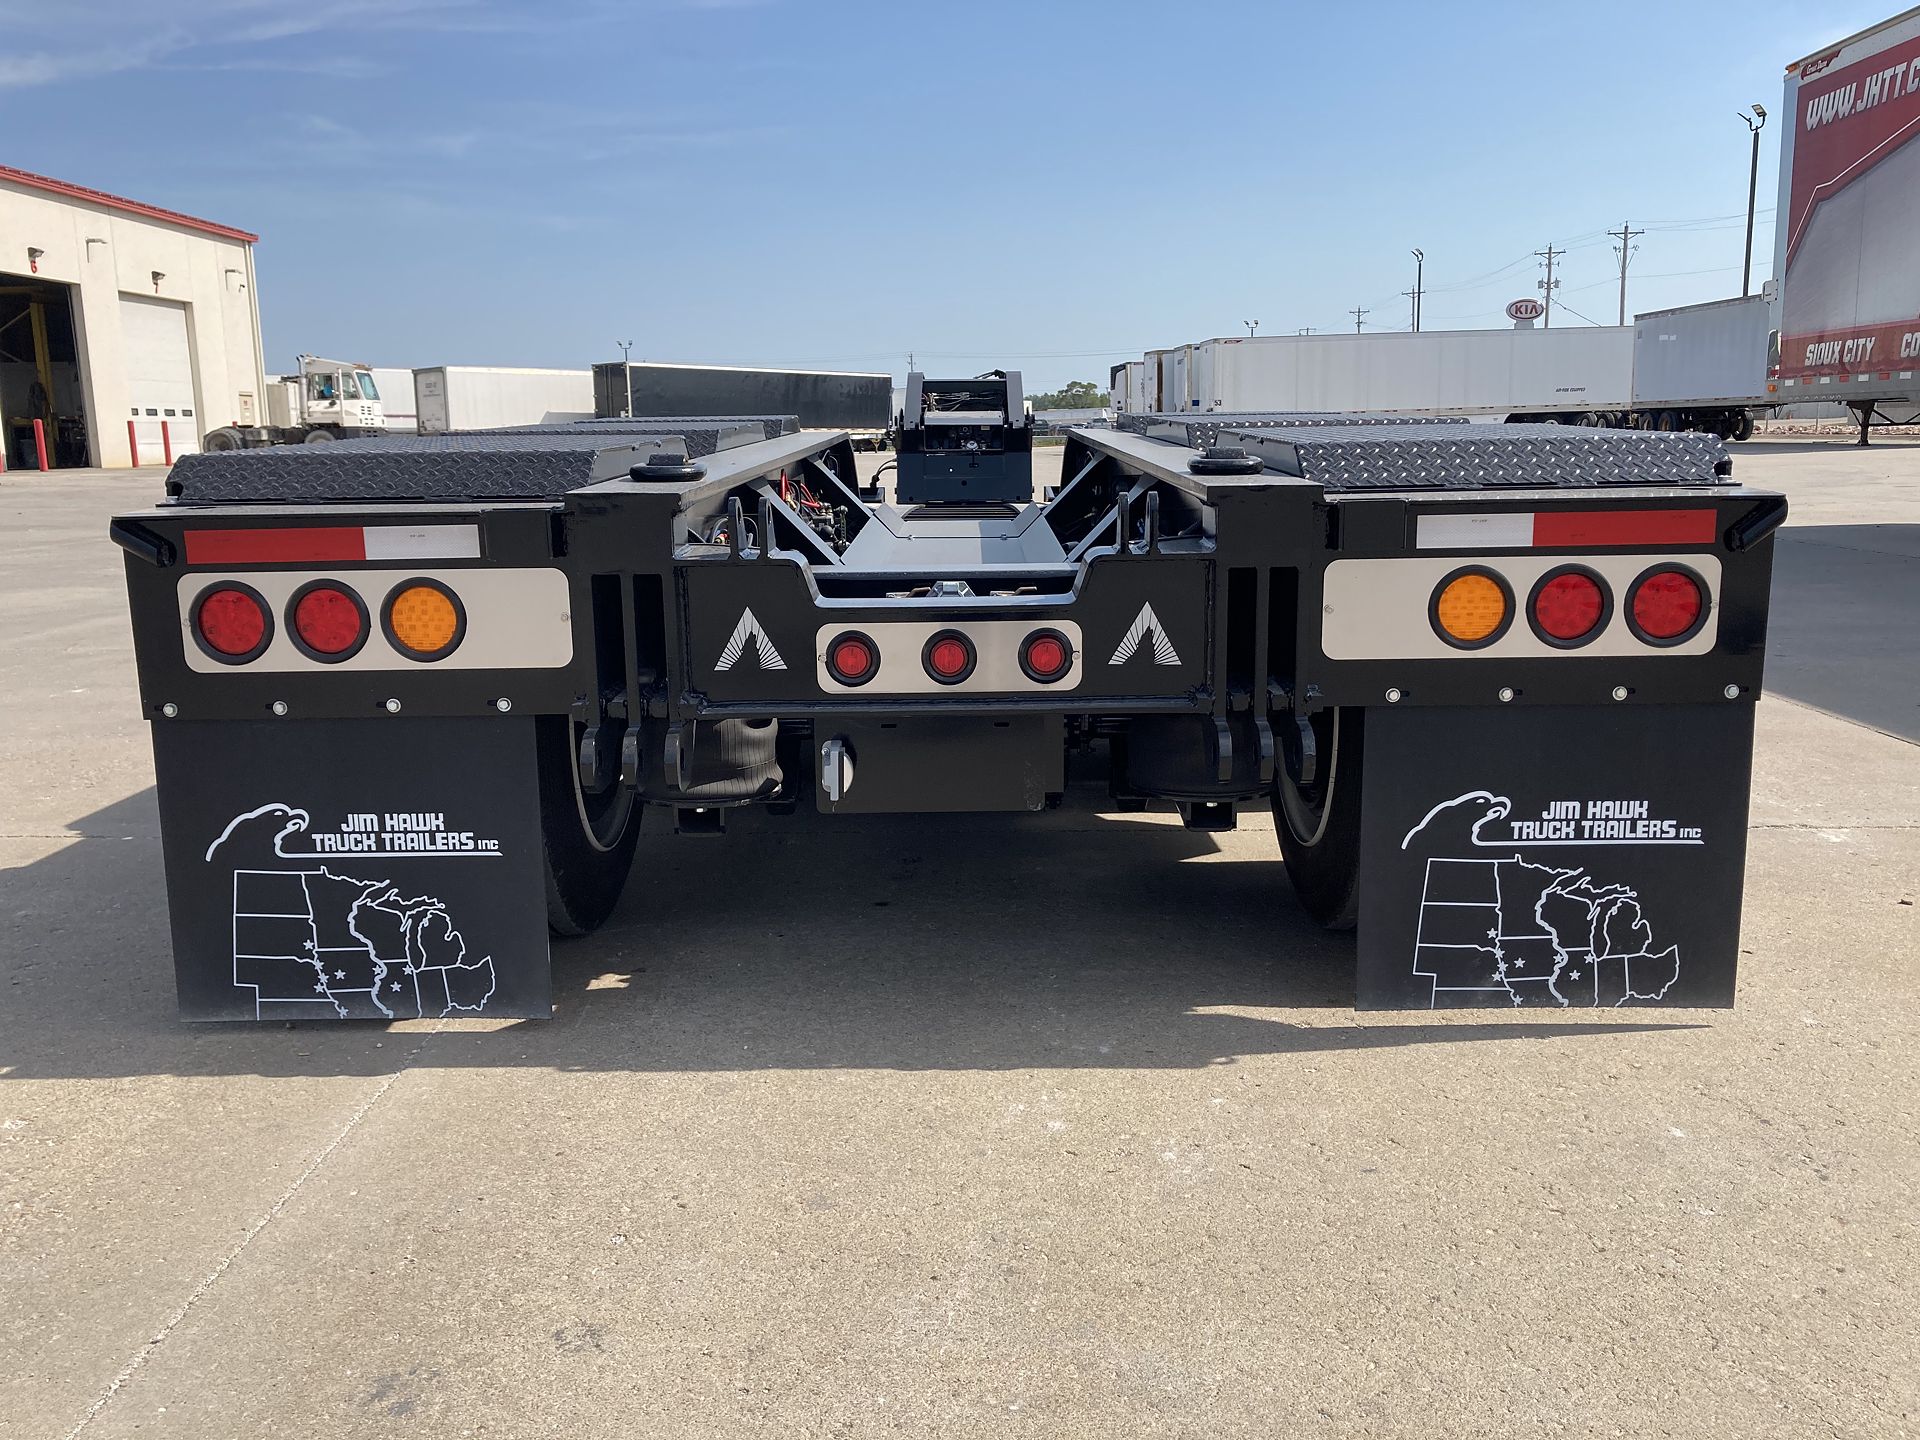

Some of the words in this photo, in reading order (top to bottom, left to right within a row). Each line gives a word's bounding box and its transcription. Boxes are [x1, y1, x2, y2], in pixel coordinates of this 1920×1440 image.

[1515, 305, 1538, 314] KIA
[1805, 340, 1842, 366] SIOUX
[1843, 337, 1876, 363] CITY
[1542, 801, 1580, 819] JIM
[1587, 800, 1648, 819] HAWK
[341, 813, 379, 832] JIM
[384, 812, 444, 831] HAWK
[1511, 821, 1576, 839] TRUCK
[1581, 820, 1677, 838] TRAILERS
[311, 833, 377, 851] TRUCK
[381, 832, 474, 851] TRAILERS
